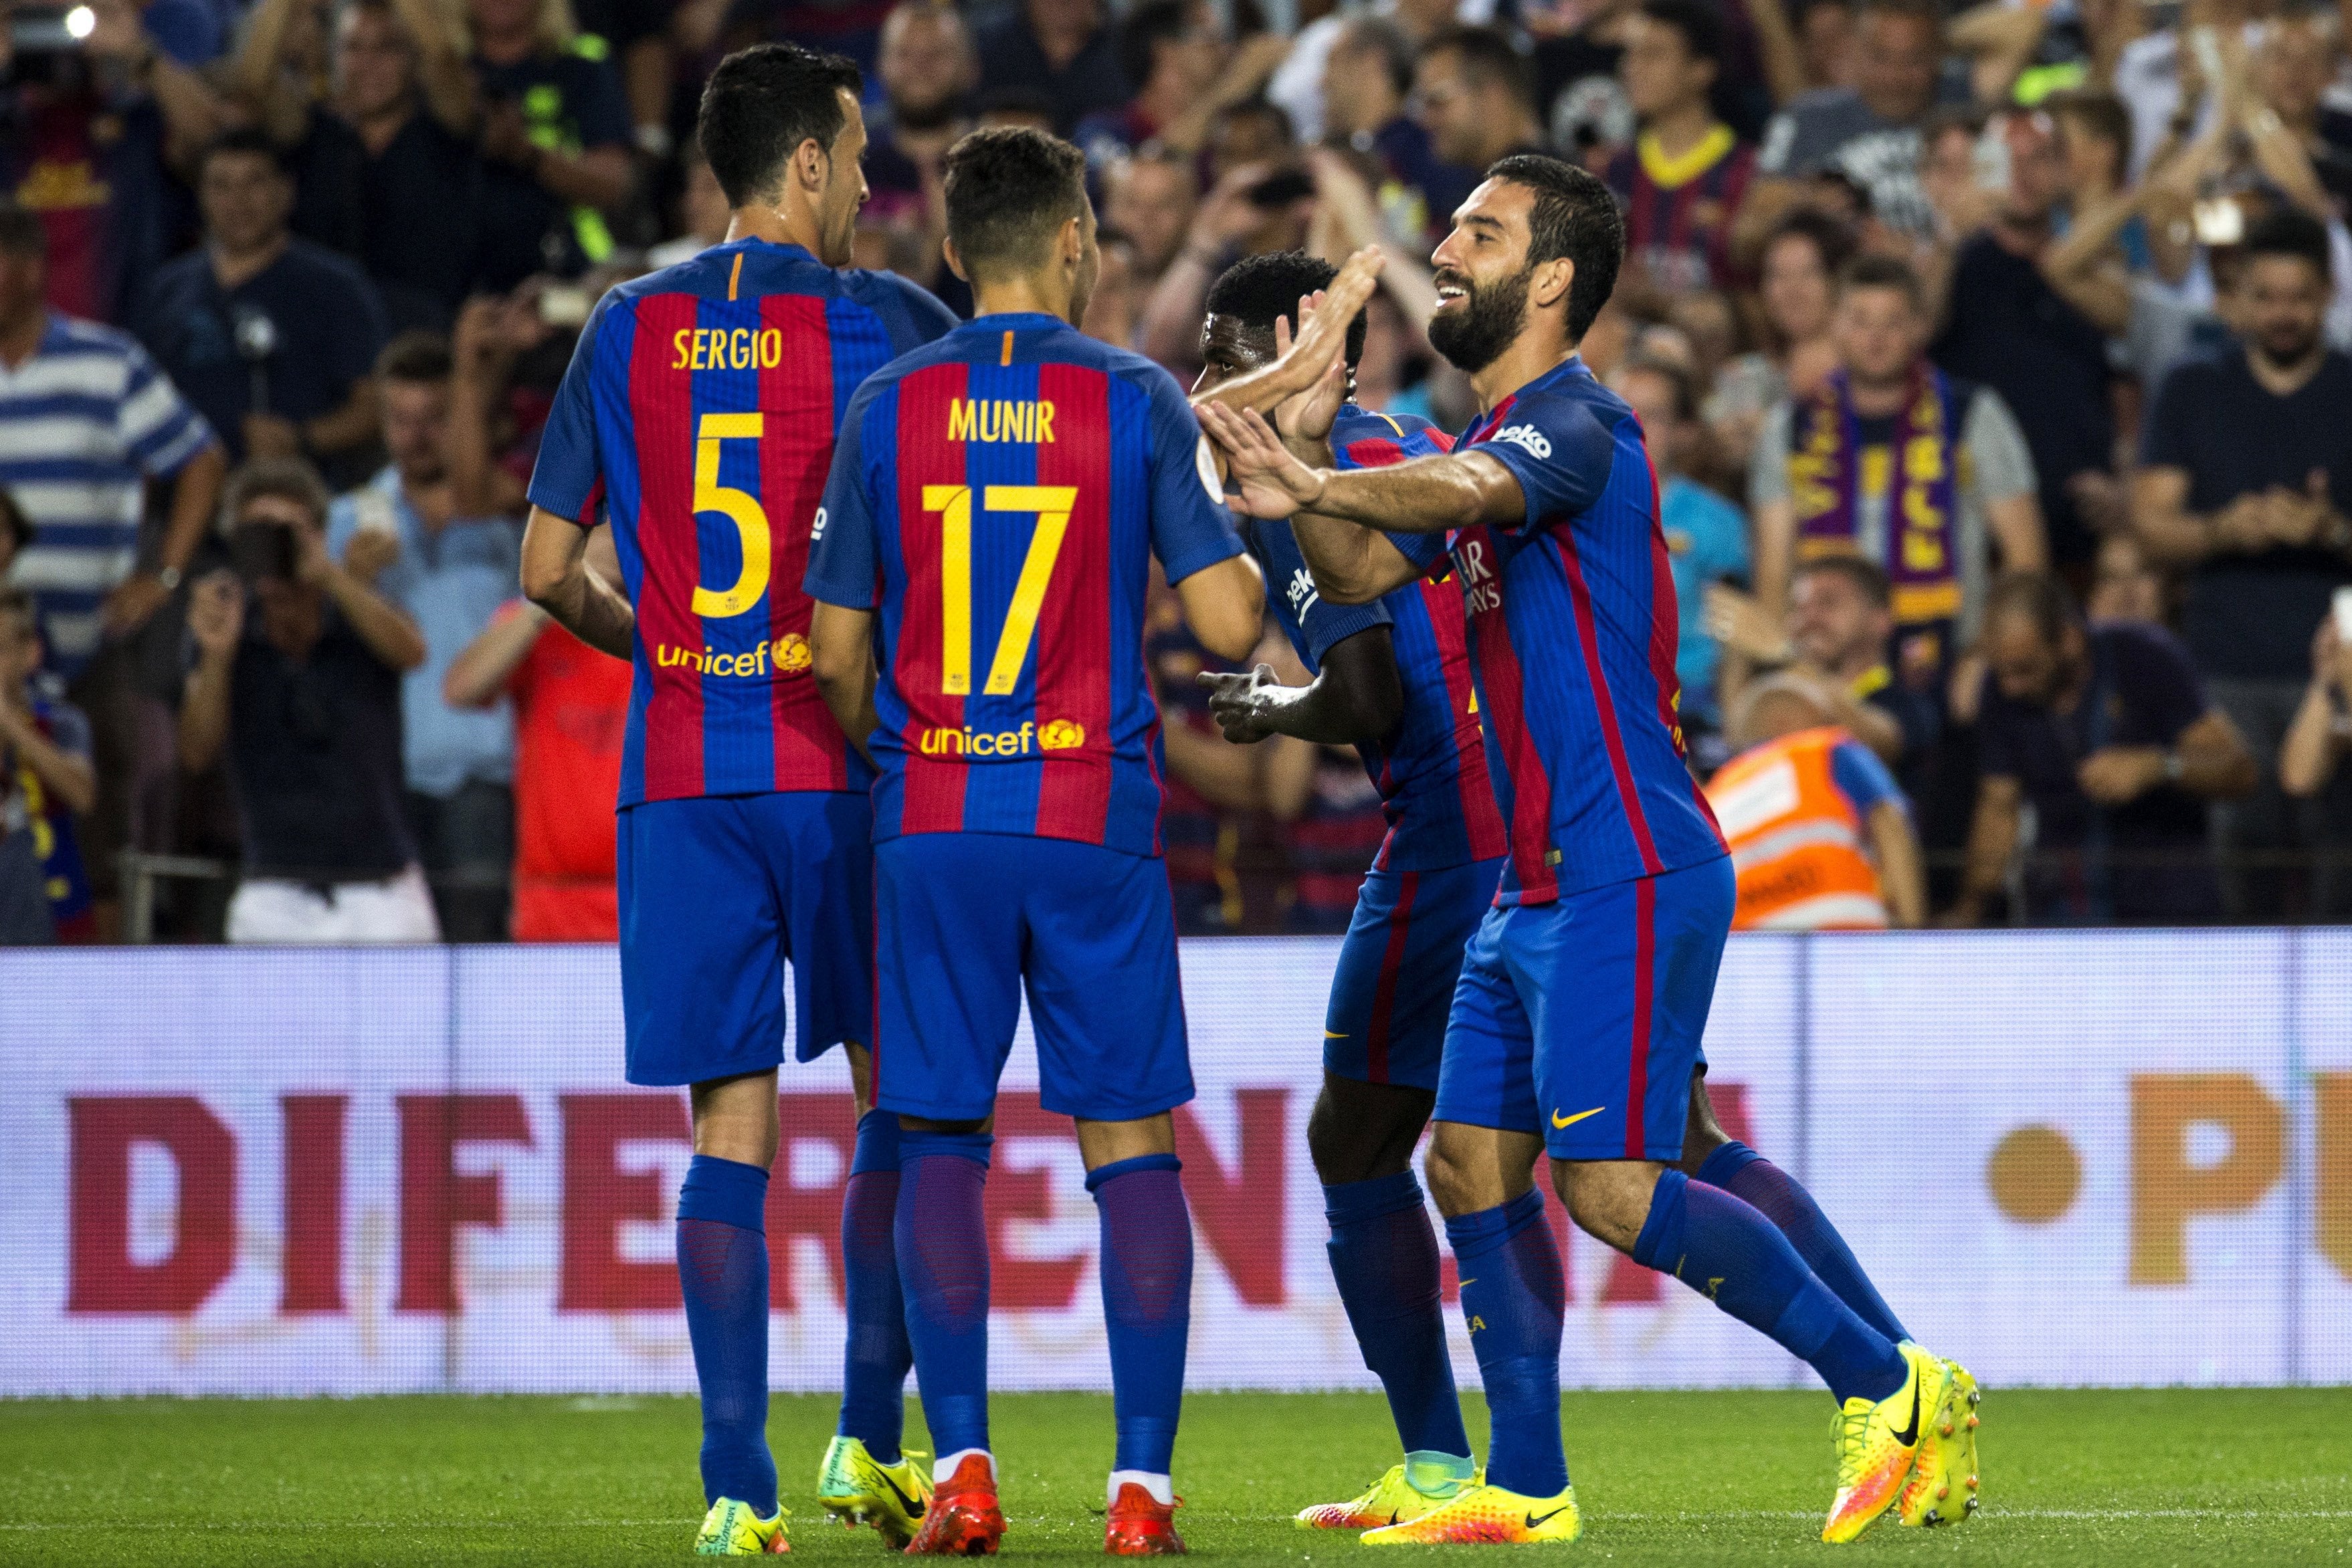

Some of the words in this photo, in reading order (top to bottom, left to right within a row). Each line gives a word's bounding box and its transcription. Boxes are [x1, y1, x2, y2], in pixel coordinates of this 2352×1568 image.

[672, 328, 782, 370] SERGIO
[947, 397, 1055, 444] MUNIR
[691, 412, 771, 618] 5
[922, 485, 1078, 695] 17
[657, 640, 769, 677] unicef
[920, 721, 1034, 756] unicef
[2127, 1070, 2352, 1287] P
